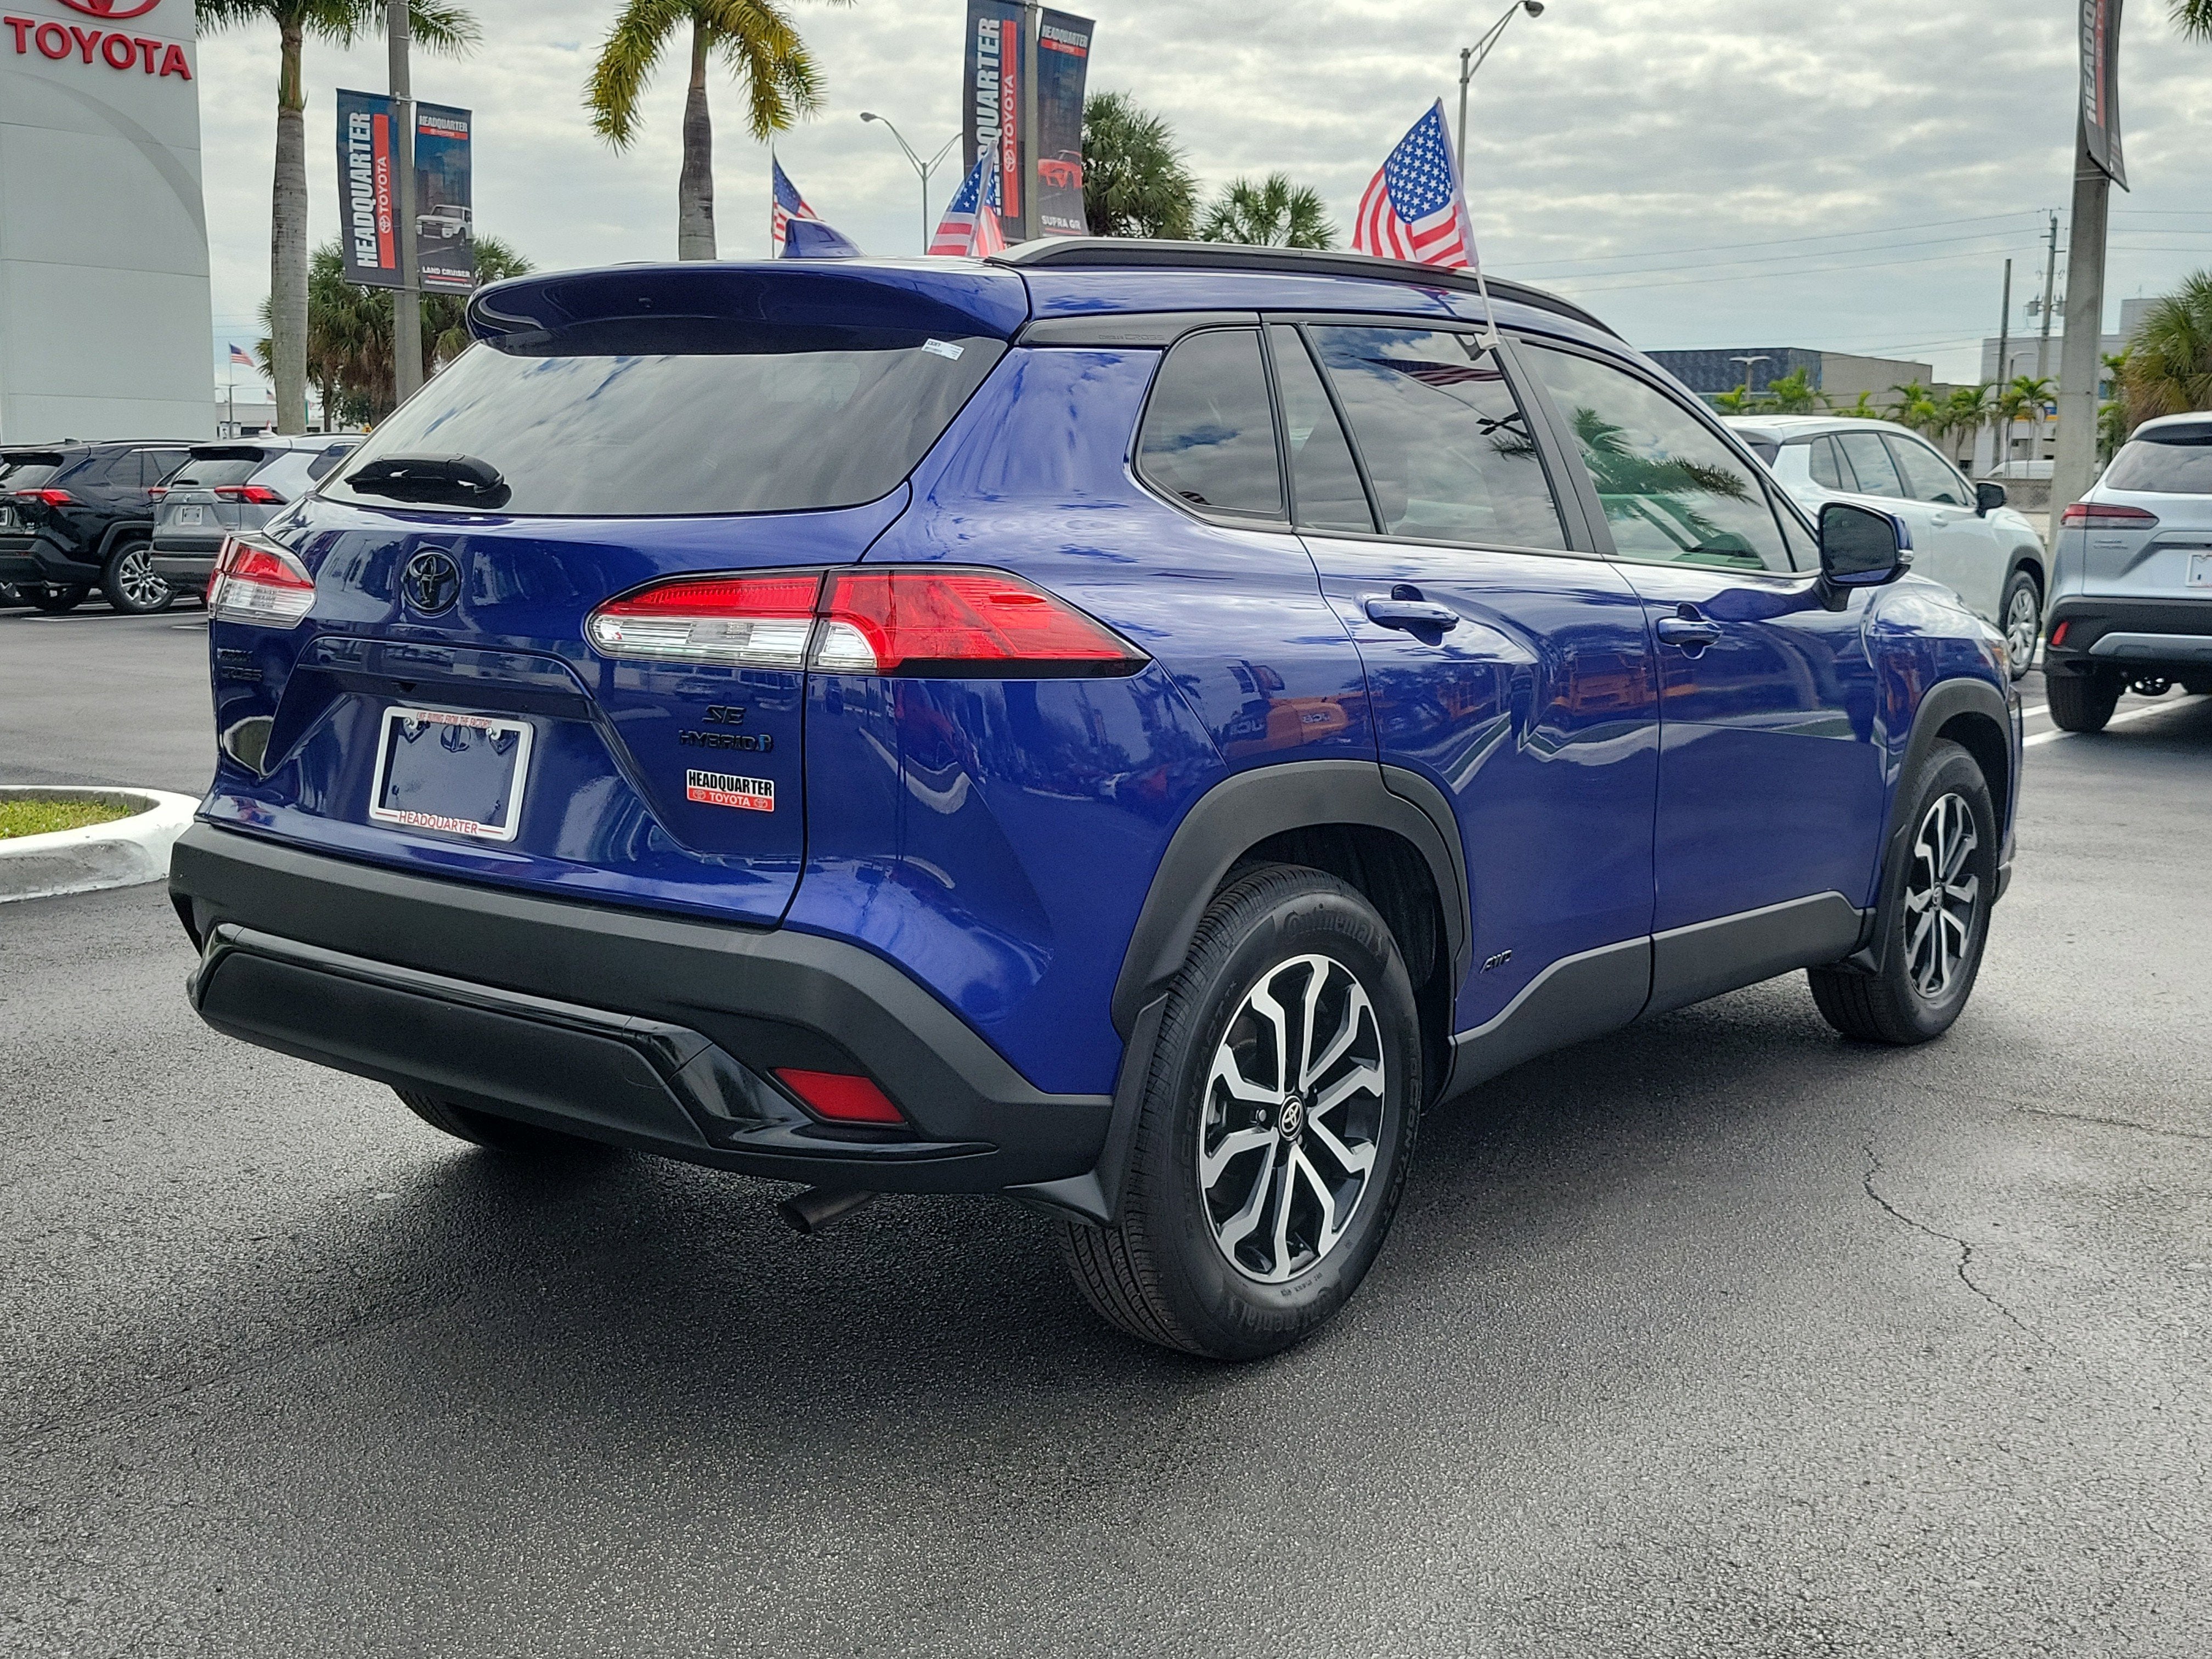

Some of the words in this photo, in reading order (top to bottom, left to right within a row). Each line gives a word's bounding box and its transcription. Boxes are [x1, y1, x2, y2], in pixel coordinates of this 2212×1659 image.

[4, 16, 192, 80] TOYOTA
[2083, 0, 2096, 124] HEADQ
[419, 115, 468, 132] HEADQUARTER
[1003, 75, 1014, 147] TOYOTA
[349, 112, 379, 268] HEADQUARTER
[377, 156, 389, 213] TOYOTA
[1041, 215, 1068, 228] SUPRA
[1069, 219, 1081, 230] GR
[422, 266, 441, 274] LAND
[702, 704, 746, 725] SE
[678, 730, 757, 751] HYBRID
[689, 771, 772, 797] HEADQUARTER
[708, 792, 751, 806] TOYOTA
[399, 811, 478, 834] HEADQUARTER
[1282, 908, 1375, 948] Continental
[1479, 949, 1512, 974] AWD
